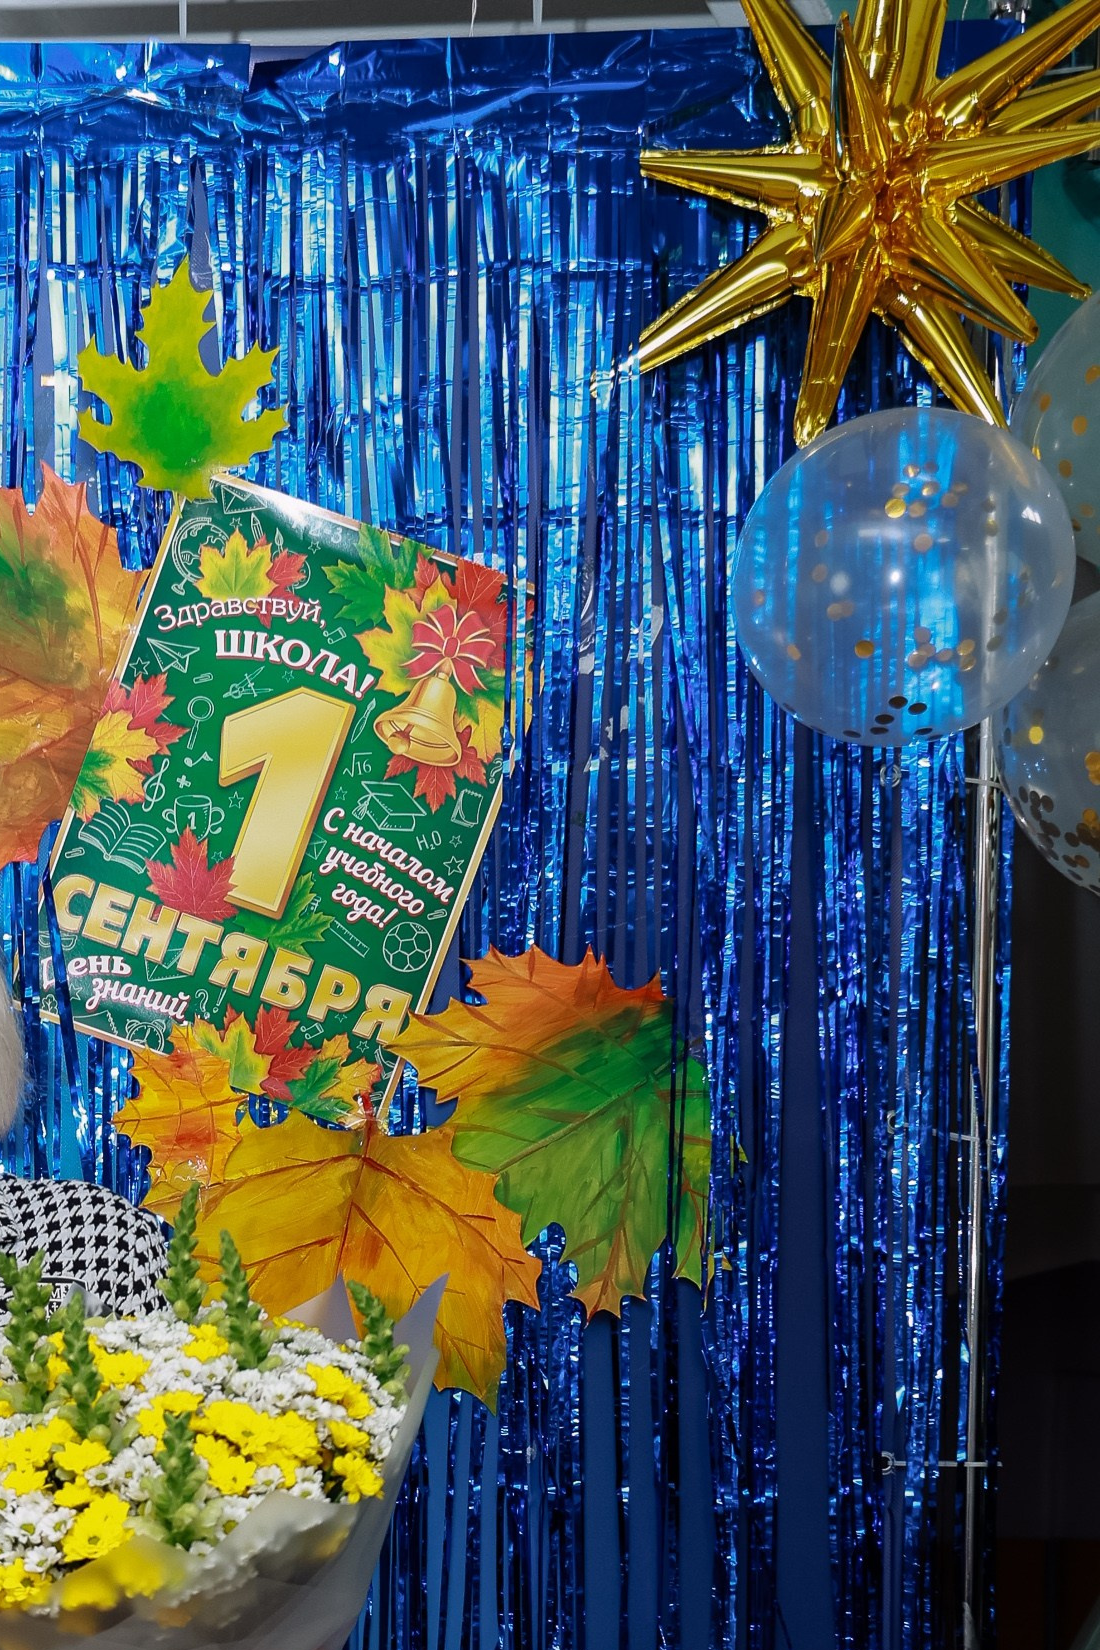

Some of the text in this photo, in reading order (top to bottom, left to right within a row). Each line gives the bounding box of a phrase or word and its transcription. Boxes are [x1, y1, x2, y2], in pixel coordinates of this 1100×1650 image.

[154, 597, 326, 631] Здравствуй,
[214, 629, 375, 699] ШКОЛА!
[219, 686, 357, 920] 1
[319, 846, 425, 916] учебного
[323, 807, 455, 904] С началом
[331, 883, 399, 929] года!
[53, 874, 413, 1046] СЕНТЯБРЯ
[86, 977, 191, 1021] знаний
